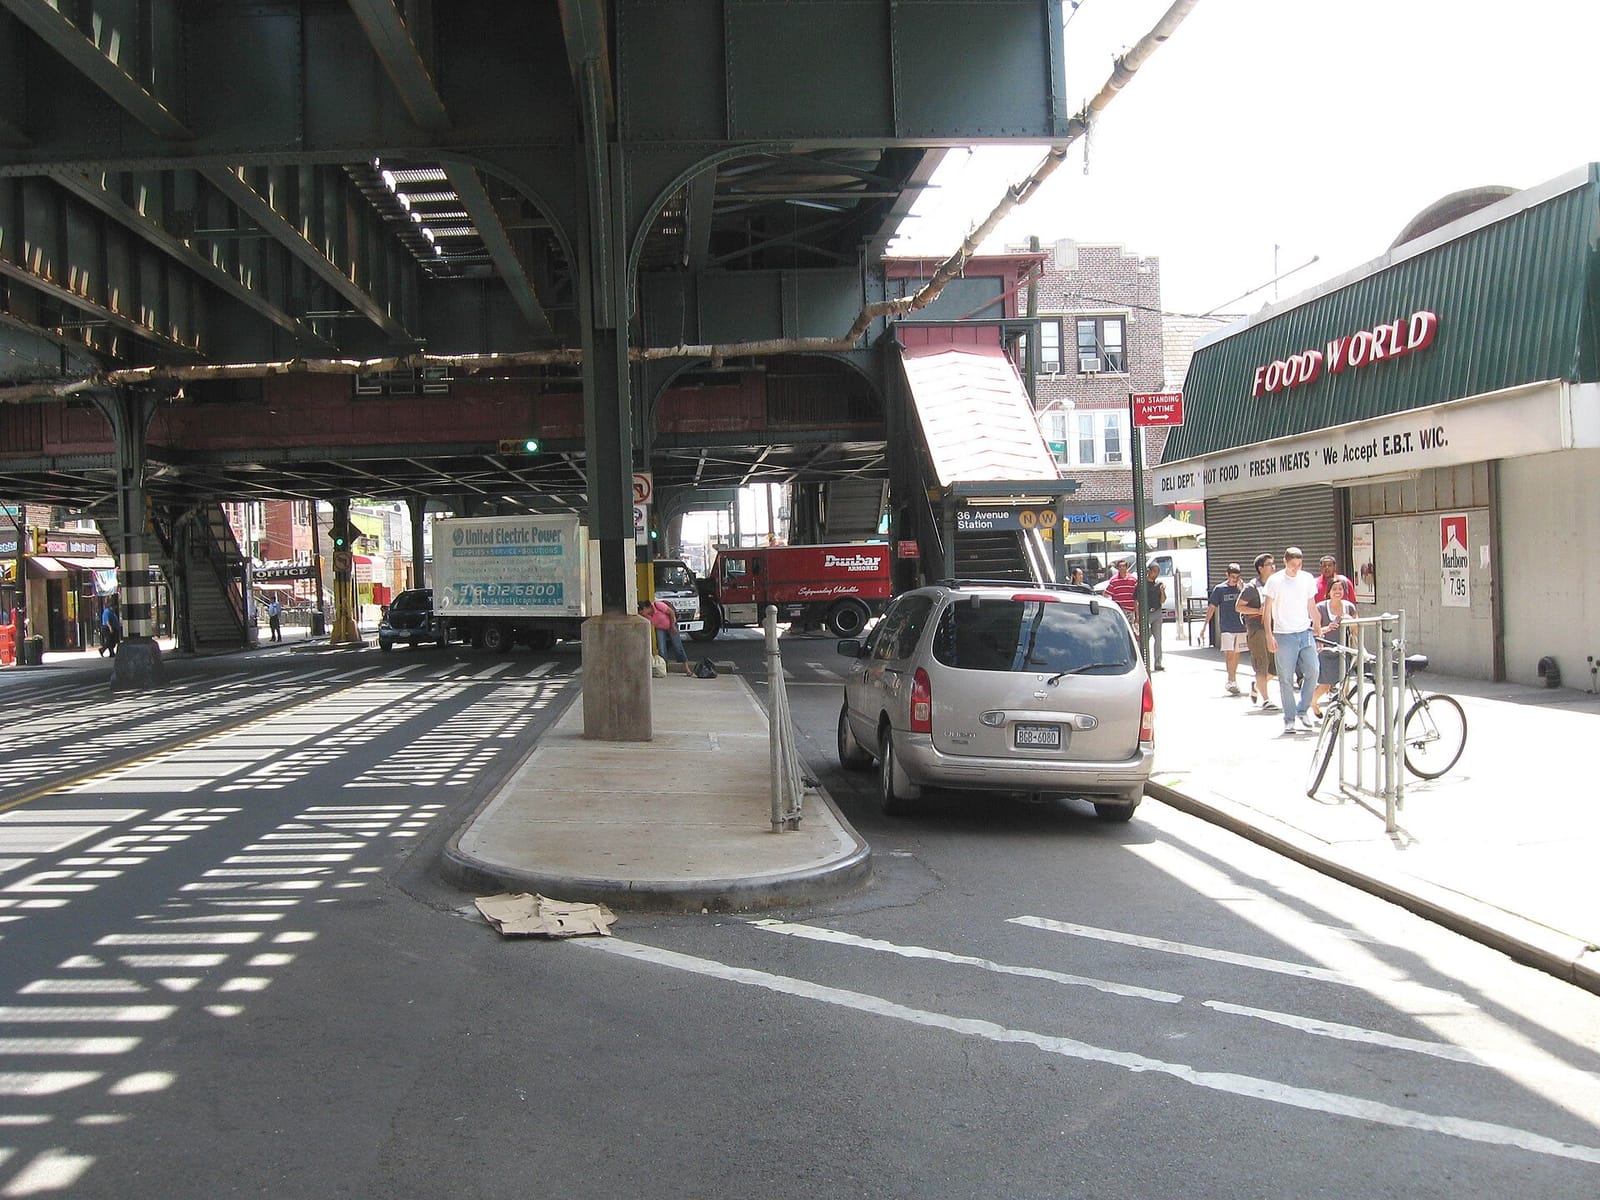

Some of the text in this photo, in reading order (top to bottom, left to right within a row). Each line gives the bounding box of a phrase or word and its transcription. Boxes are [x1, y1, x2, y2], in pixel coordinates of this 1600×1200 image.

[1252, 310, 1438, 397] FOOD WORLD
[1136, 395, 1180, 404] NO STANDING
[1141, 404, 1175, 414] ANYTIME
[1161, 426, 1449, 492] DELI DEPT. HOT FOOD FRESH MEATS We Accept E.B.T. WIC.
[957, 511, 1010, 520] 36 Avenue
[1066, 512, 1101, 523] merica
[957, 520, 993, 529] Station
[465, 526, 562, 545] United Electric Power
[824, 554, 882, 567] Dunbar
[1442, 548, 1468, 569] Marlboro
[256, 568, 309, 579] OFFICE
[1450, 577, 1466, 596] 7.95
